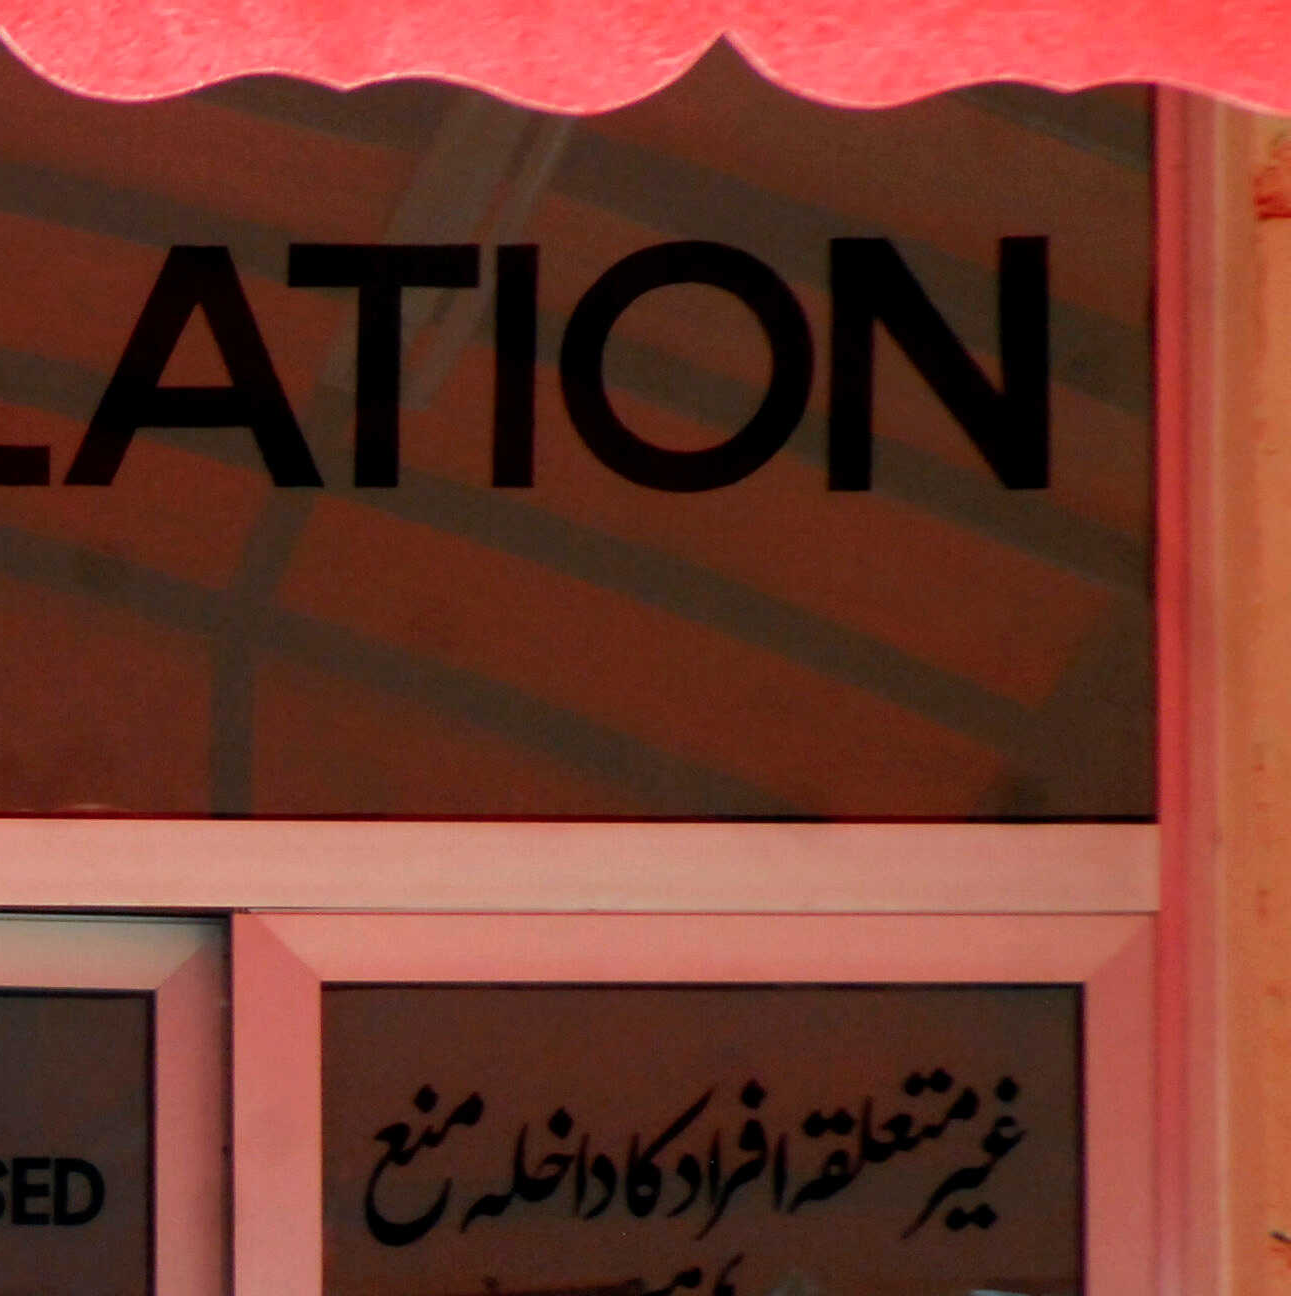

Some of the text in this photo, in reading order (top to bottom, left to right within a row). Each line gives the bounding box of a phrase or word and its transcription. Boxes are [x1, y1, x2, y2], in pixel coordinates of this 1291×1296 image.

[364, 1066, 1027, 1247] غیر متعلقہ افراد کا داخلہ منع
